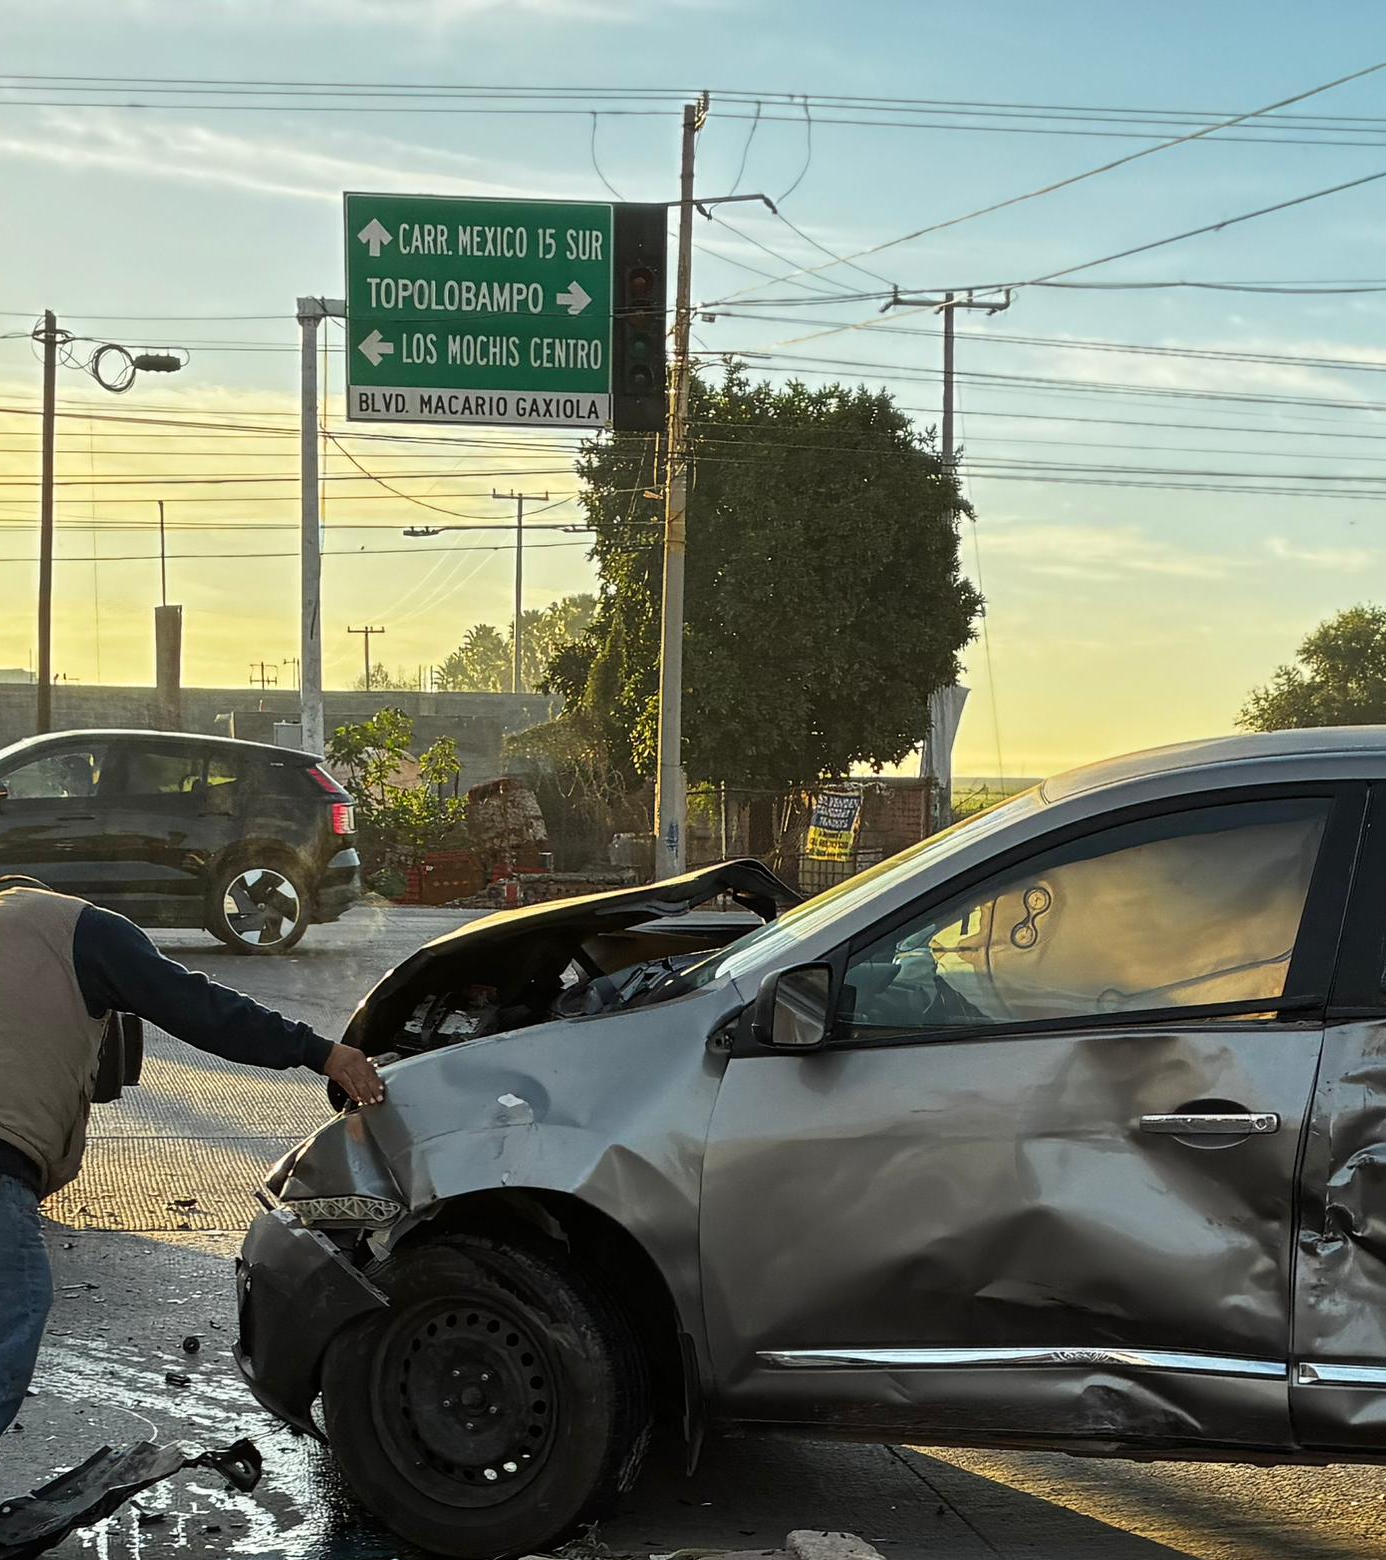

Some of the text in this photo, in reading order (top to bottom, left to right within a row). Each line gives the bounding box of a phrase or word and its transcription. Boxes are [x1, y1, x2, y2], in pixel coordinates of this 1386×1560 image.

[399, 223, 603, 260] CARR. MEXICO 15 SUR
[366, 277, 544, 314] TOPOLOBAMPO
[402, 333, 602, 370] LOS MOCHIS CENTRO
[358, 392, 599, 420] BLVD. MACARIO GAXIOLA
